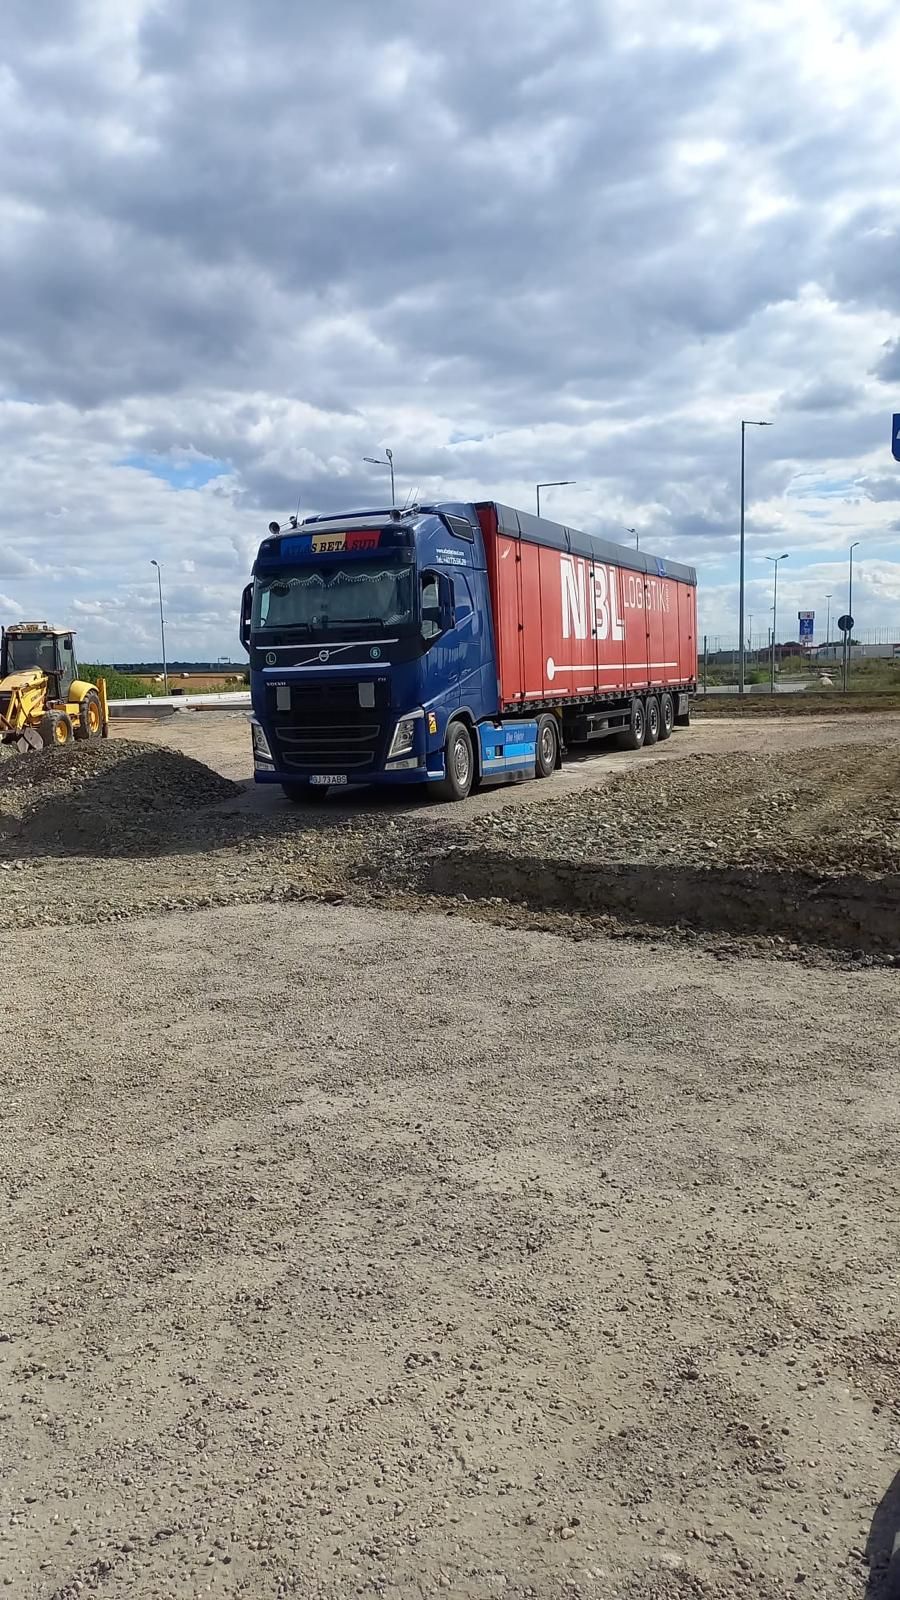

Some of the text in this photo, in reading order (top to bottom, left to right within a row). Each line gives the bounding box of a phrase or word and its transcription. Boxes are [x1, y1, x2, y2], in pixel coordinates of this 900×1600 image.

[320, 541, 347, 552] BETA
[560, 553, 625, 641] NBL
[622, 574, 666, 612] LOGISTIK
